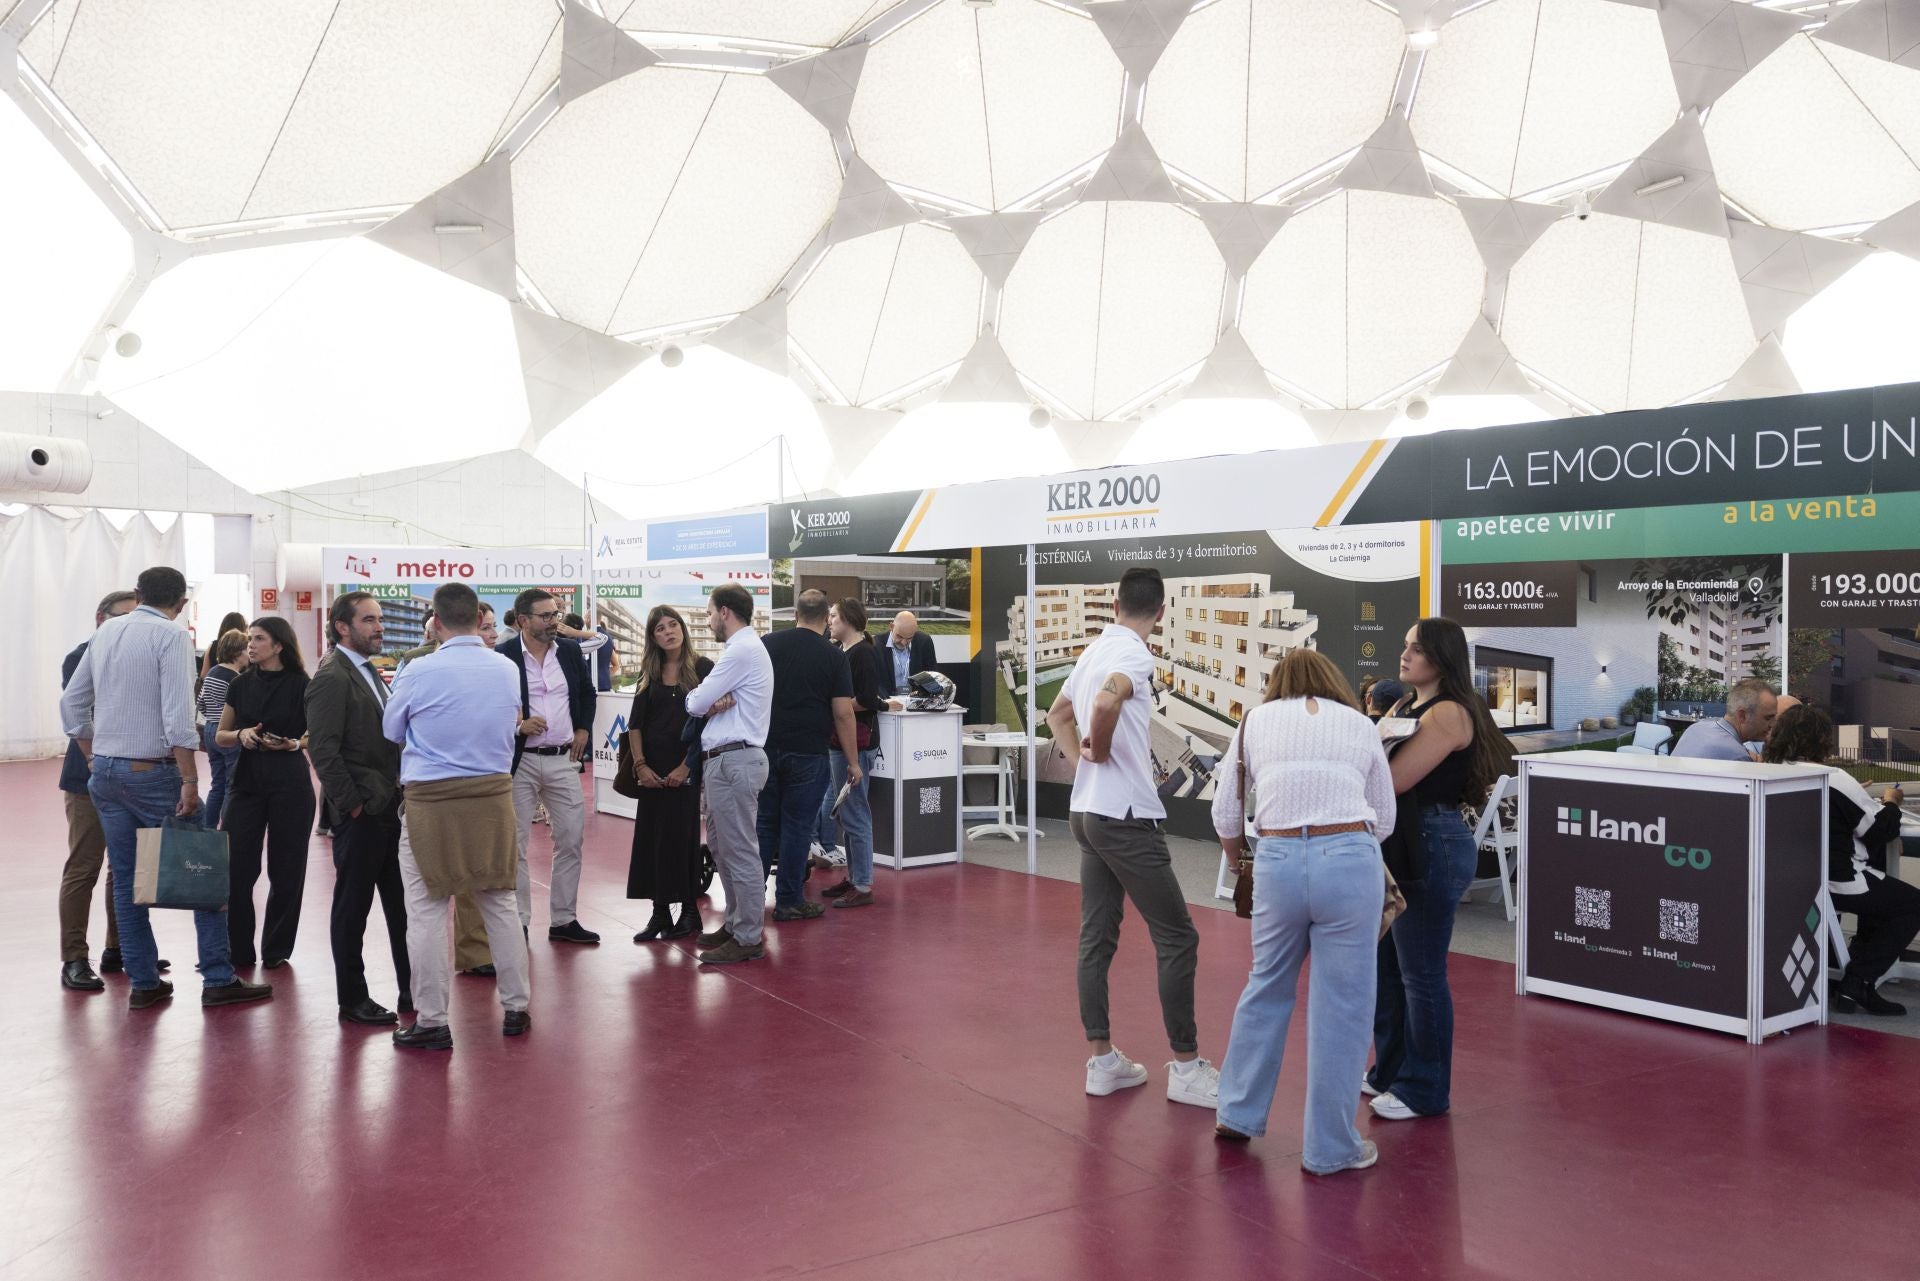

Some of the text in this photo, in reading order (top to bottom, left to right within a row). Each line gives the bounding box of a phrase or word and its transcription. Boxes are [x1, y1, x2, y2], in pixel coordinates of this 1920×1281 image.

[1466, 416, 1916, 491] LA EMOCIÓN DE UN
[1046, 473, 1161, 512] KER 2000
[1723, 496, 1877, 524] a la venta
[807, 510, 851, 528] KER 2000
[1047, 516, 1157, 535] INMOBILIARIA
[1457, 510, 1616, 541] apetece vivir
[807, 530, 849, 538] INMOBILIARIA
[1107, 543, 1257, 562] Viviendas de 3 y 4 dormitorios
[1298, 543, 1329, 552] Viviendas
[1330, 542, 1338, 550] de
[1339, 542, 1346, 551] 2,
[1353, 543, 1358, 551] y
[1364, 540, 1405, 549] dormitorios
[1034, 548, 1092, 565] CISTÉRNIGA
[396, 558, 475, 578] metro
[594, 587, 639, 596] OYRA III
[1463, 580, 1544, 600] 163.000€
[1617, 578, 1739, 592] Arroyo de la Encomienda
[1689, 592, 1739, 602] Valladolid
[1820, 600, 1839, 608] CON
[1841, 600, 1877, 608] GARAJE
[1887, 599, 1920, 607] TRAST
[1509, 602, 1544, 610] TRASTERO
[595, 750, 613, 761] REAL
[923, 749, 948, 757] SUQUIA
[1590, 809, 1666, 846] land
[1664, 844, 1712, 870] co
[1563, 932, 1586, 945] land
[1653, 948, 1678, 961] land
[1691, 962, 1711, 970] Arroyo
